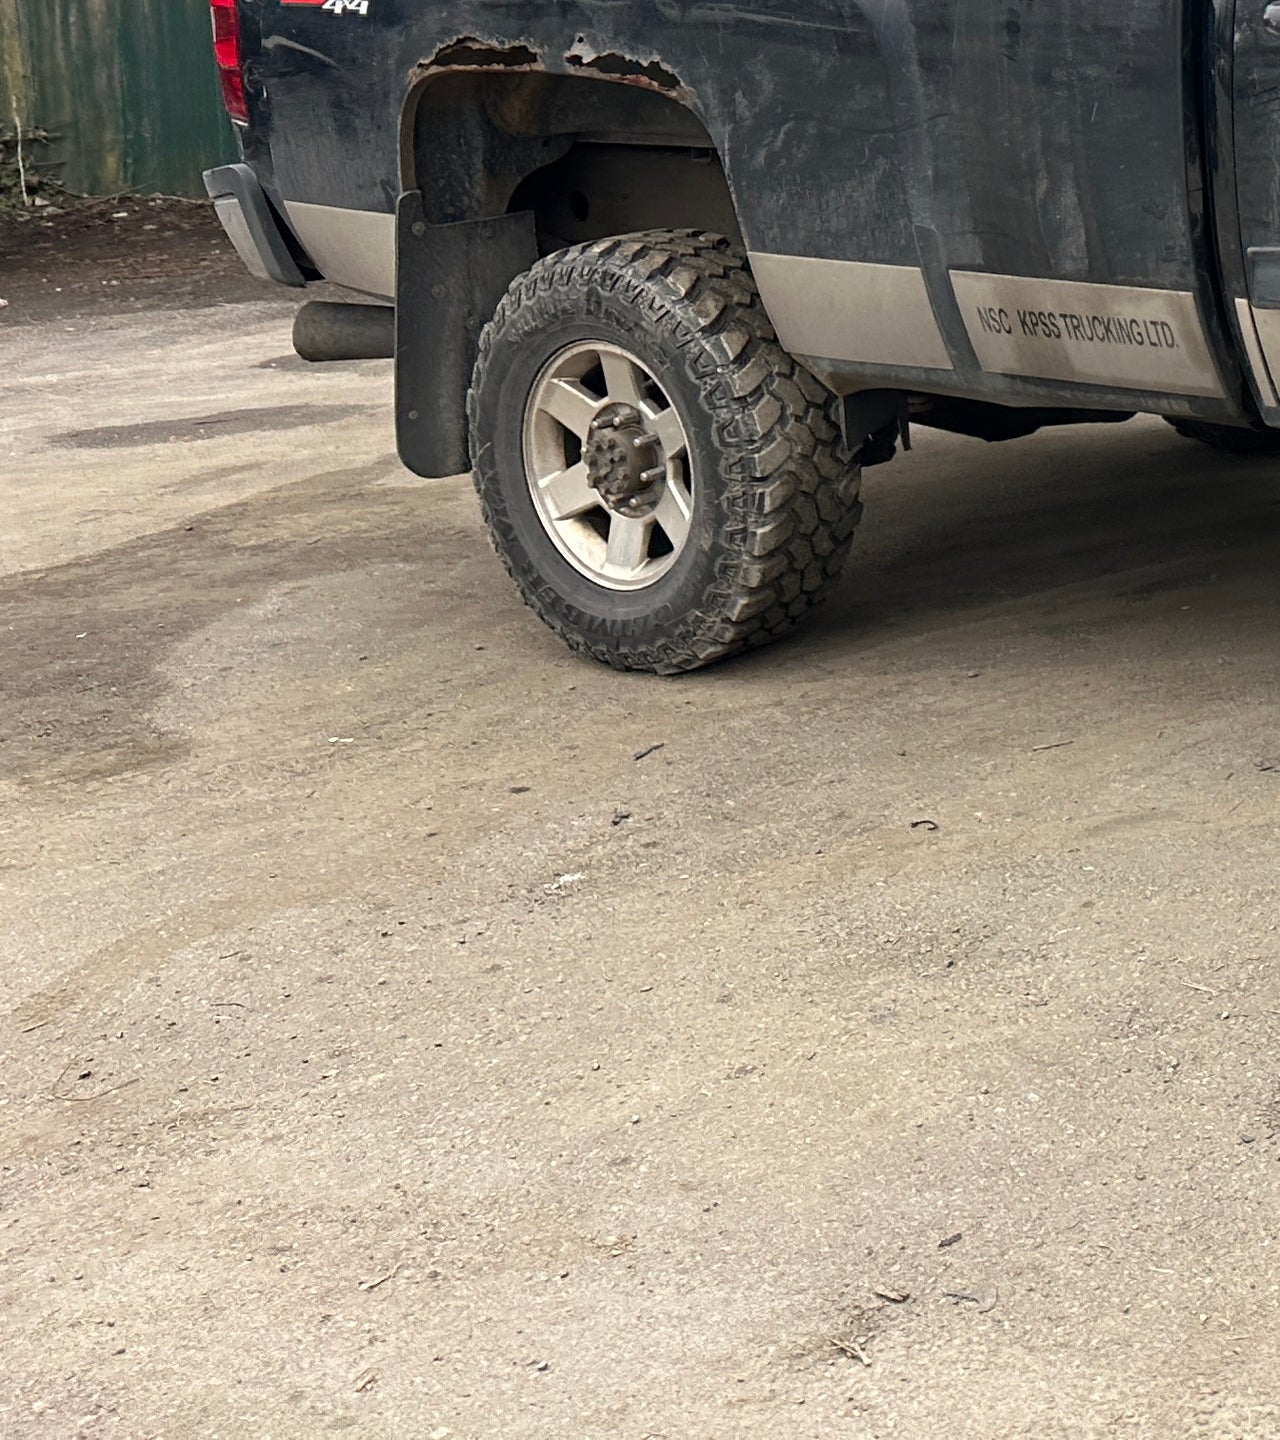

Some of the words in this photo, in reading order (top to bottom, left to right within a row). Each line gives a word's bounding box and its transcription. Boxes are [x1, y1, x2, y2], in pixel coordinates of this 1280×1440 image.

[976, 305, 1012, 335] NSC
[1017, 309, 1062, 340] KPSS
[1059, 313, 1144, 347] TRUCKING
[1143, 320, 1180, 350] LTD.
